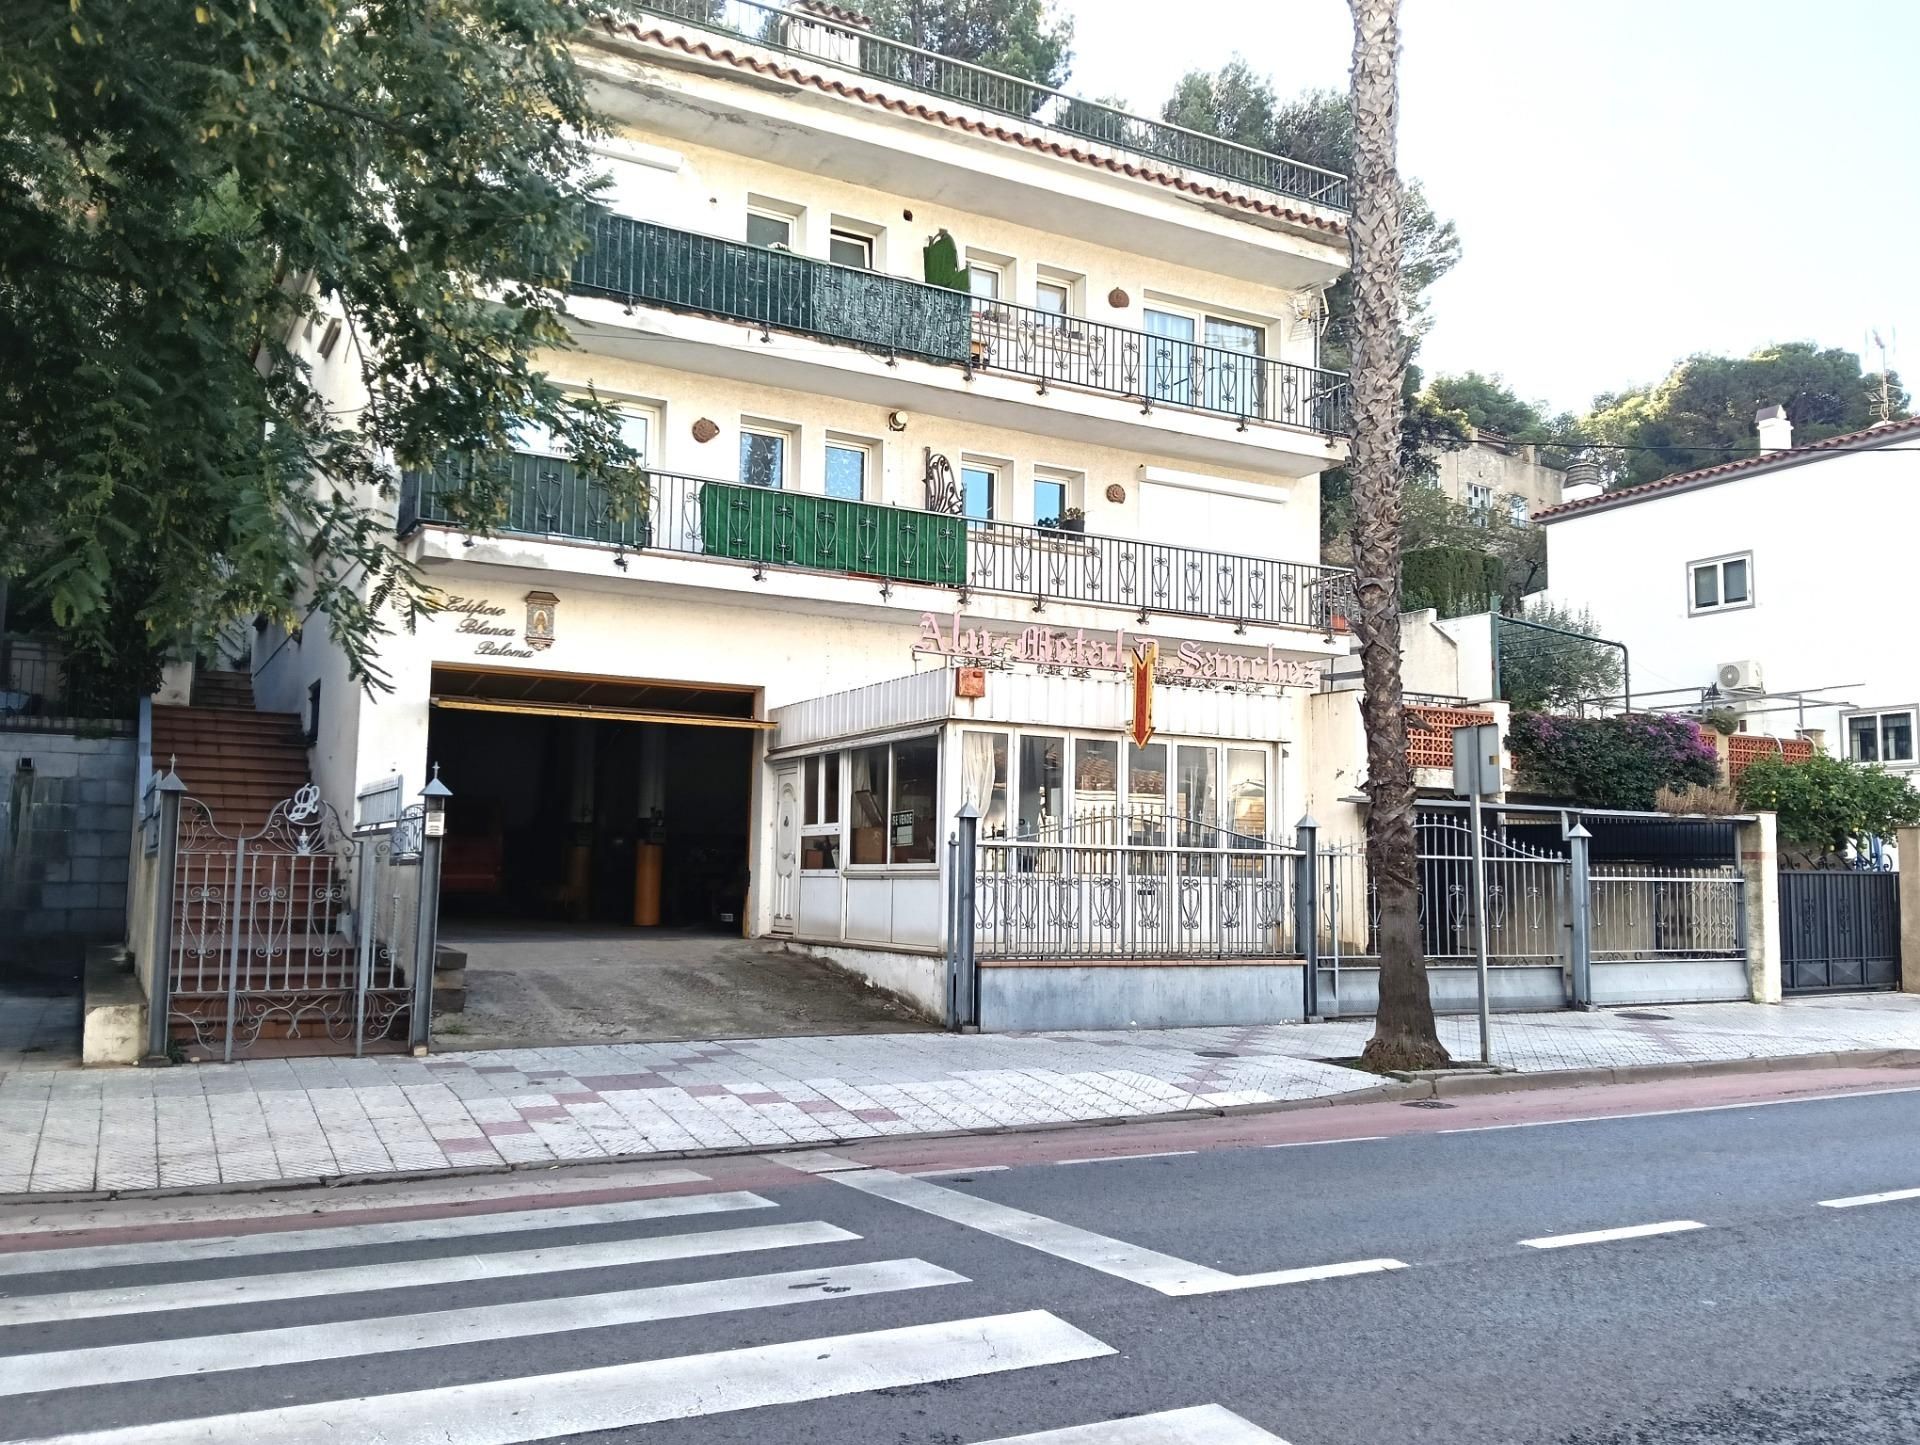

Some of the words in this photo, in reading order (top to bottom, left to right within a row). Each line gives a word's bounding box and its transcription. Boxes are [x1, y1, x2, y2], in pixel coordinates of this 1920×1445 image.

[447, 595, 506, 618] Edificio
[456, 618, 516, 636] Blanca
[474, 641, 534, 658] Paloma
[899, 812, 913, 825] VENDE
